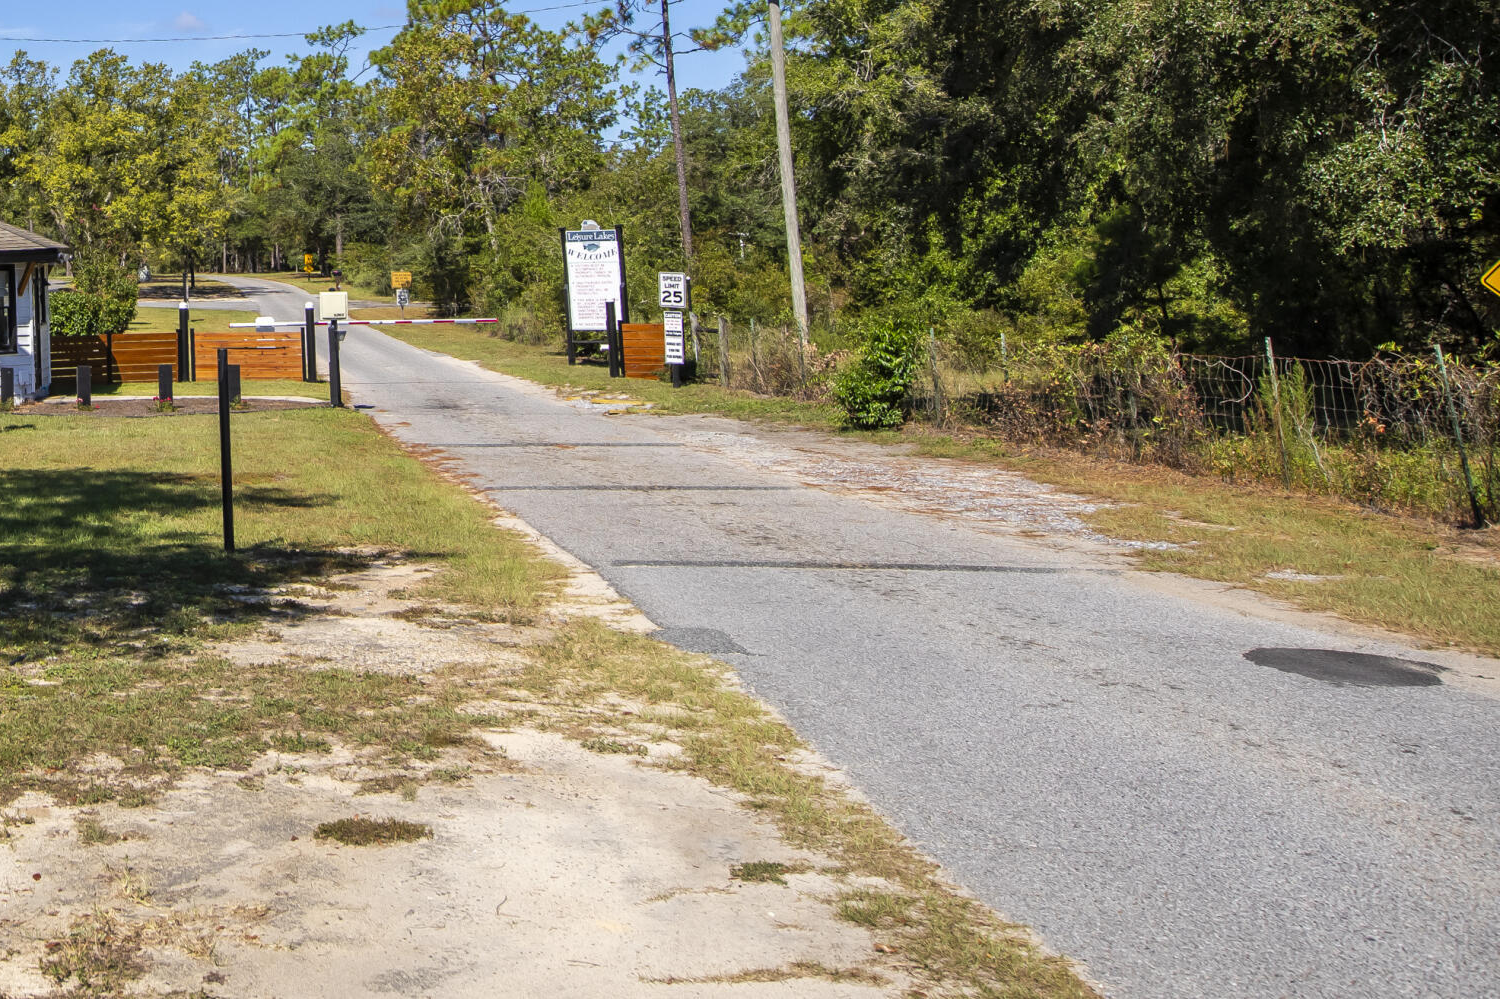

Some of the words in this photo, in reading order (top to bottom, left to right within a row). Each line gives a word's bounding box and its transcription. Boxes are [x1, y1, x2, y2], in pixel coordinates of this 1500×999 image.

[567, 232, 594, 241] Leisure
[593, 231, 615, 241] Lakes
[568, 246, 618, 260] WELCOME
[661, 290, 683, 304] 25
